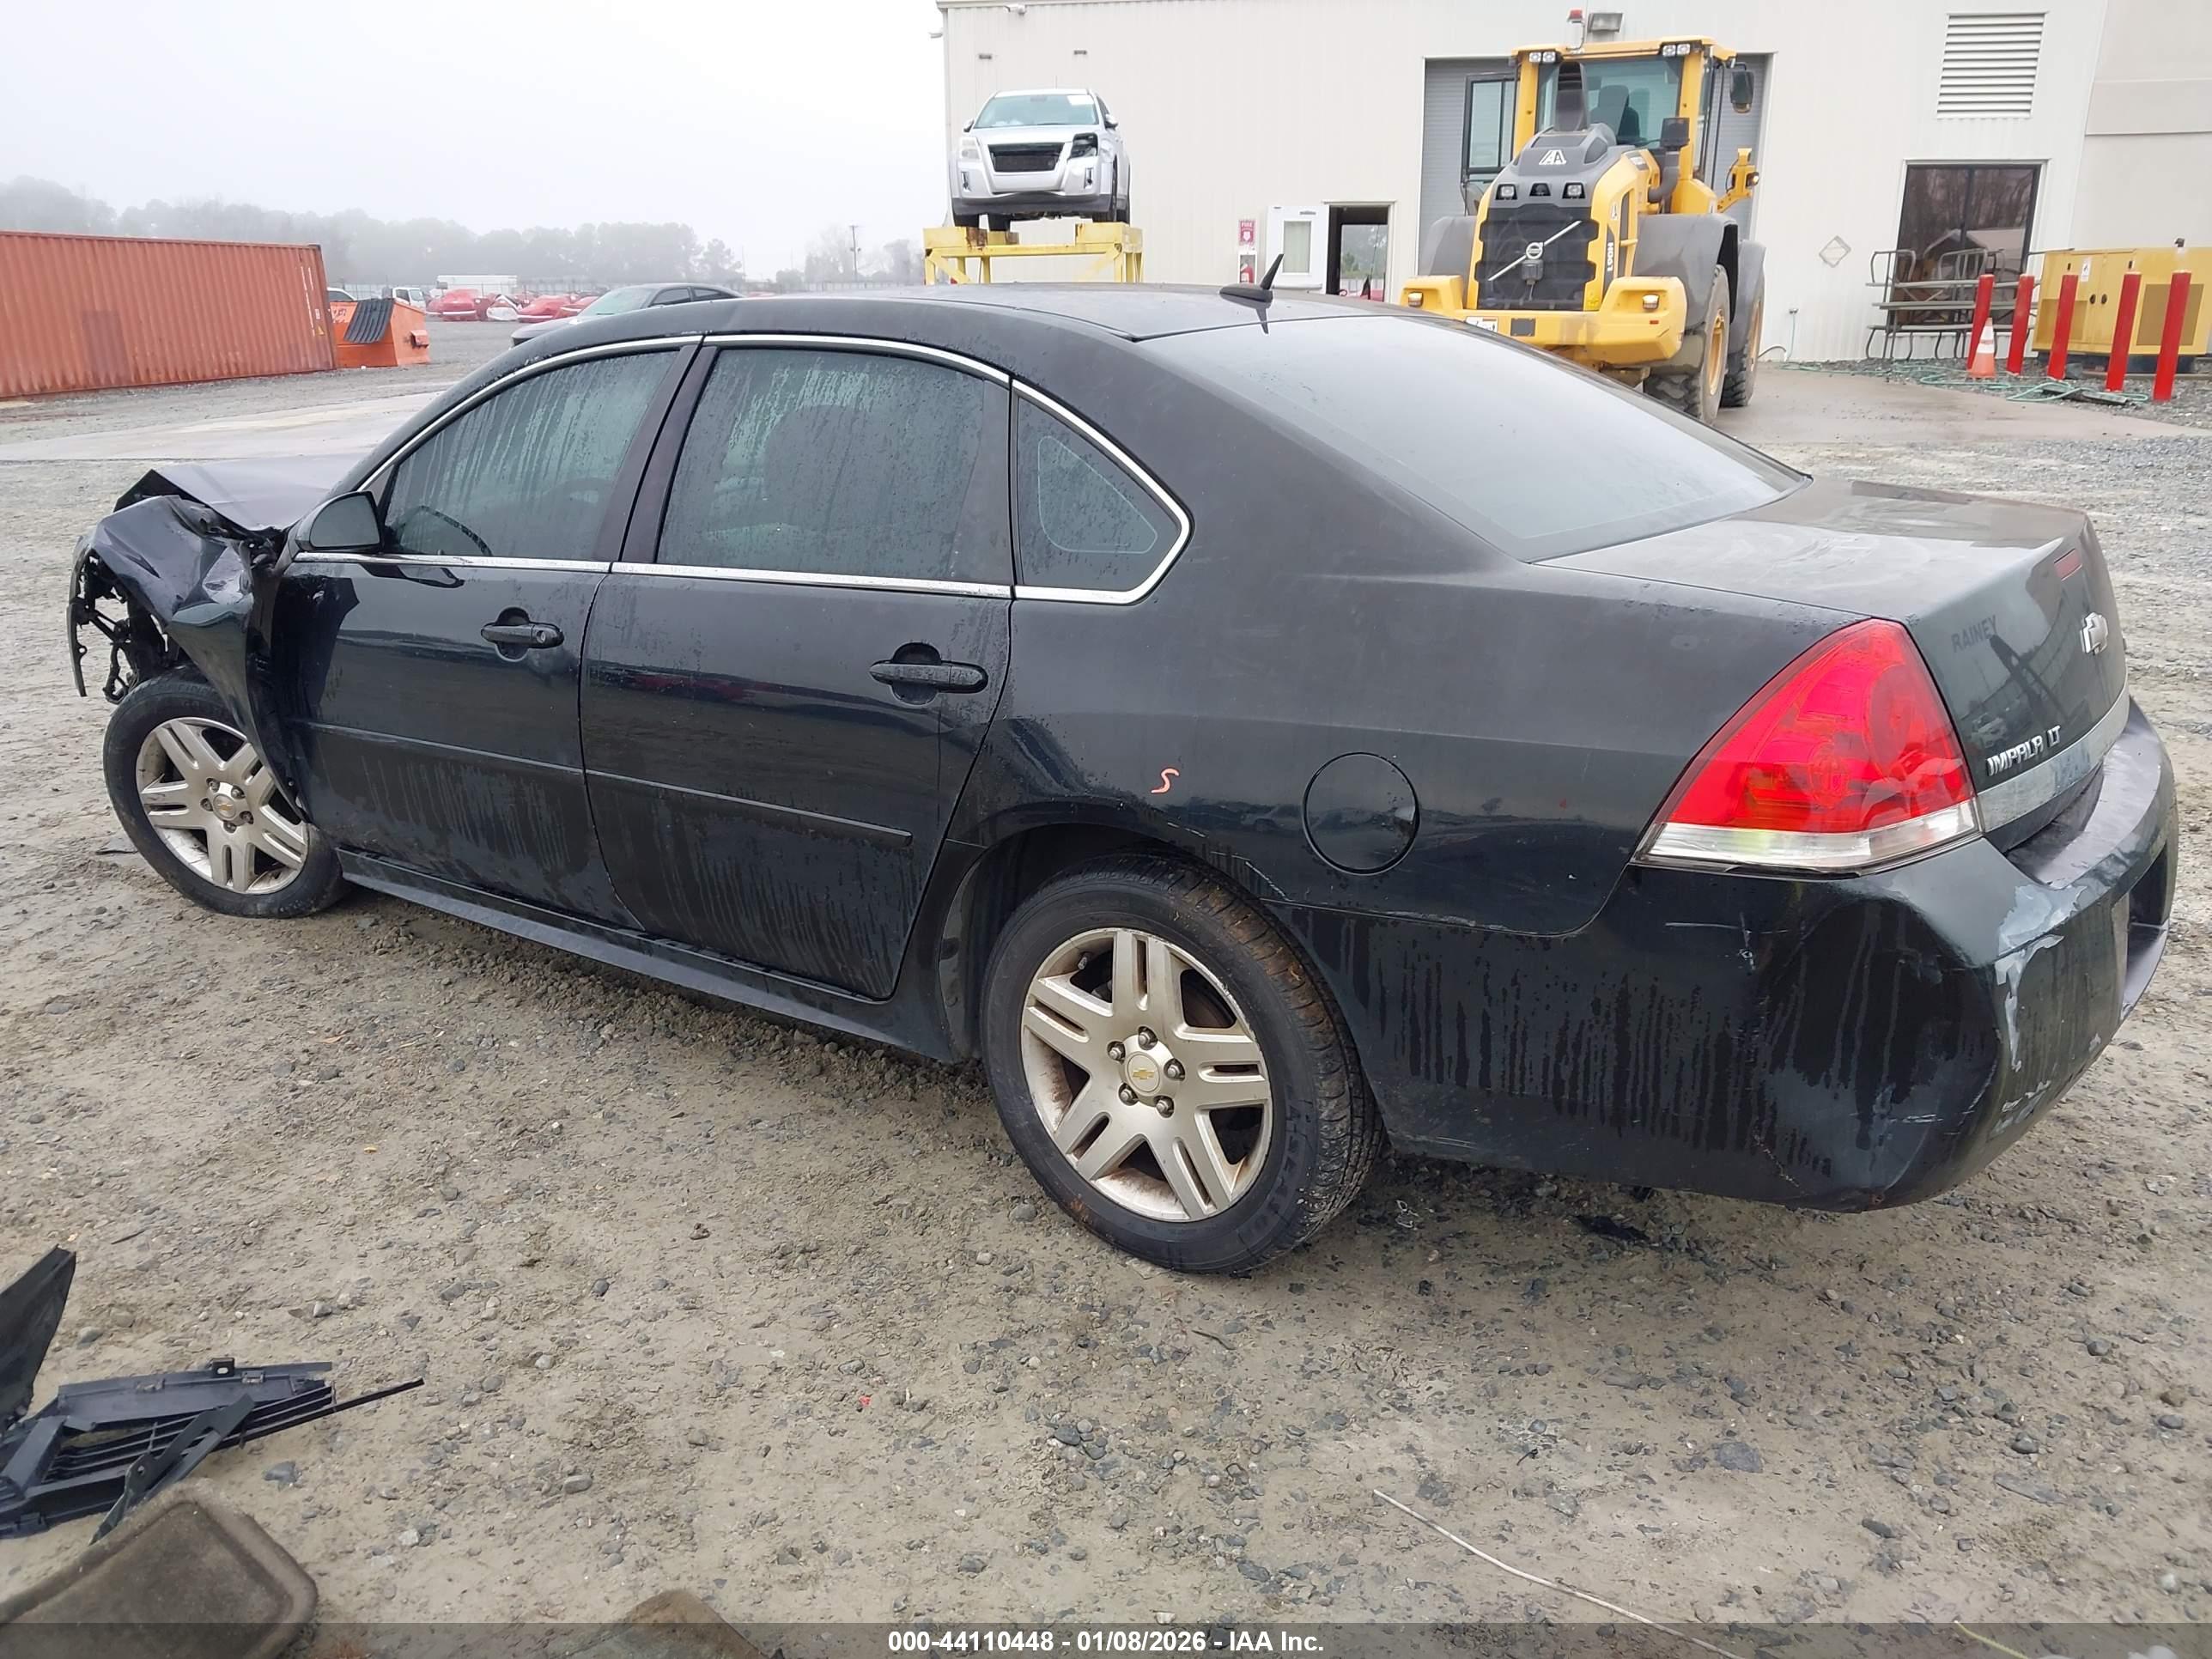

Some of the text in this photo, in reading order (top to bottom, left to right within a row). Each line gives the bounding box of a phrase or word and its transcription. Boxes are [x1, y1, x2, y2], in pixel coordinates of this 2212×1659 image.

[1950, 614, 1998, 653] RAINEY
[1986, 725, 2061, 776] IMPALA LT
